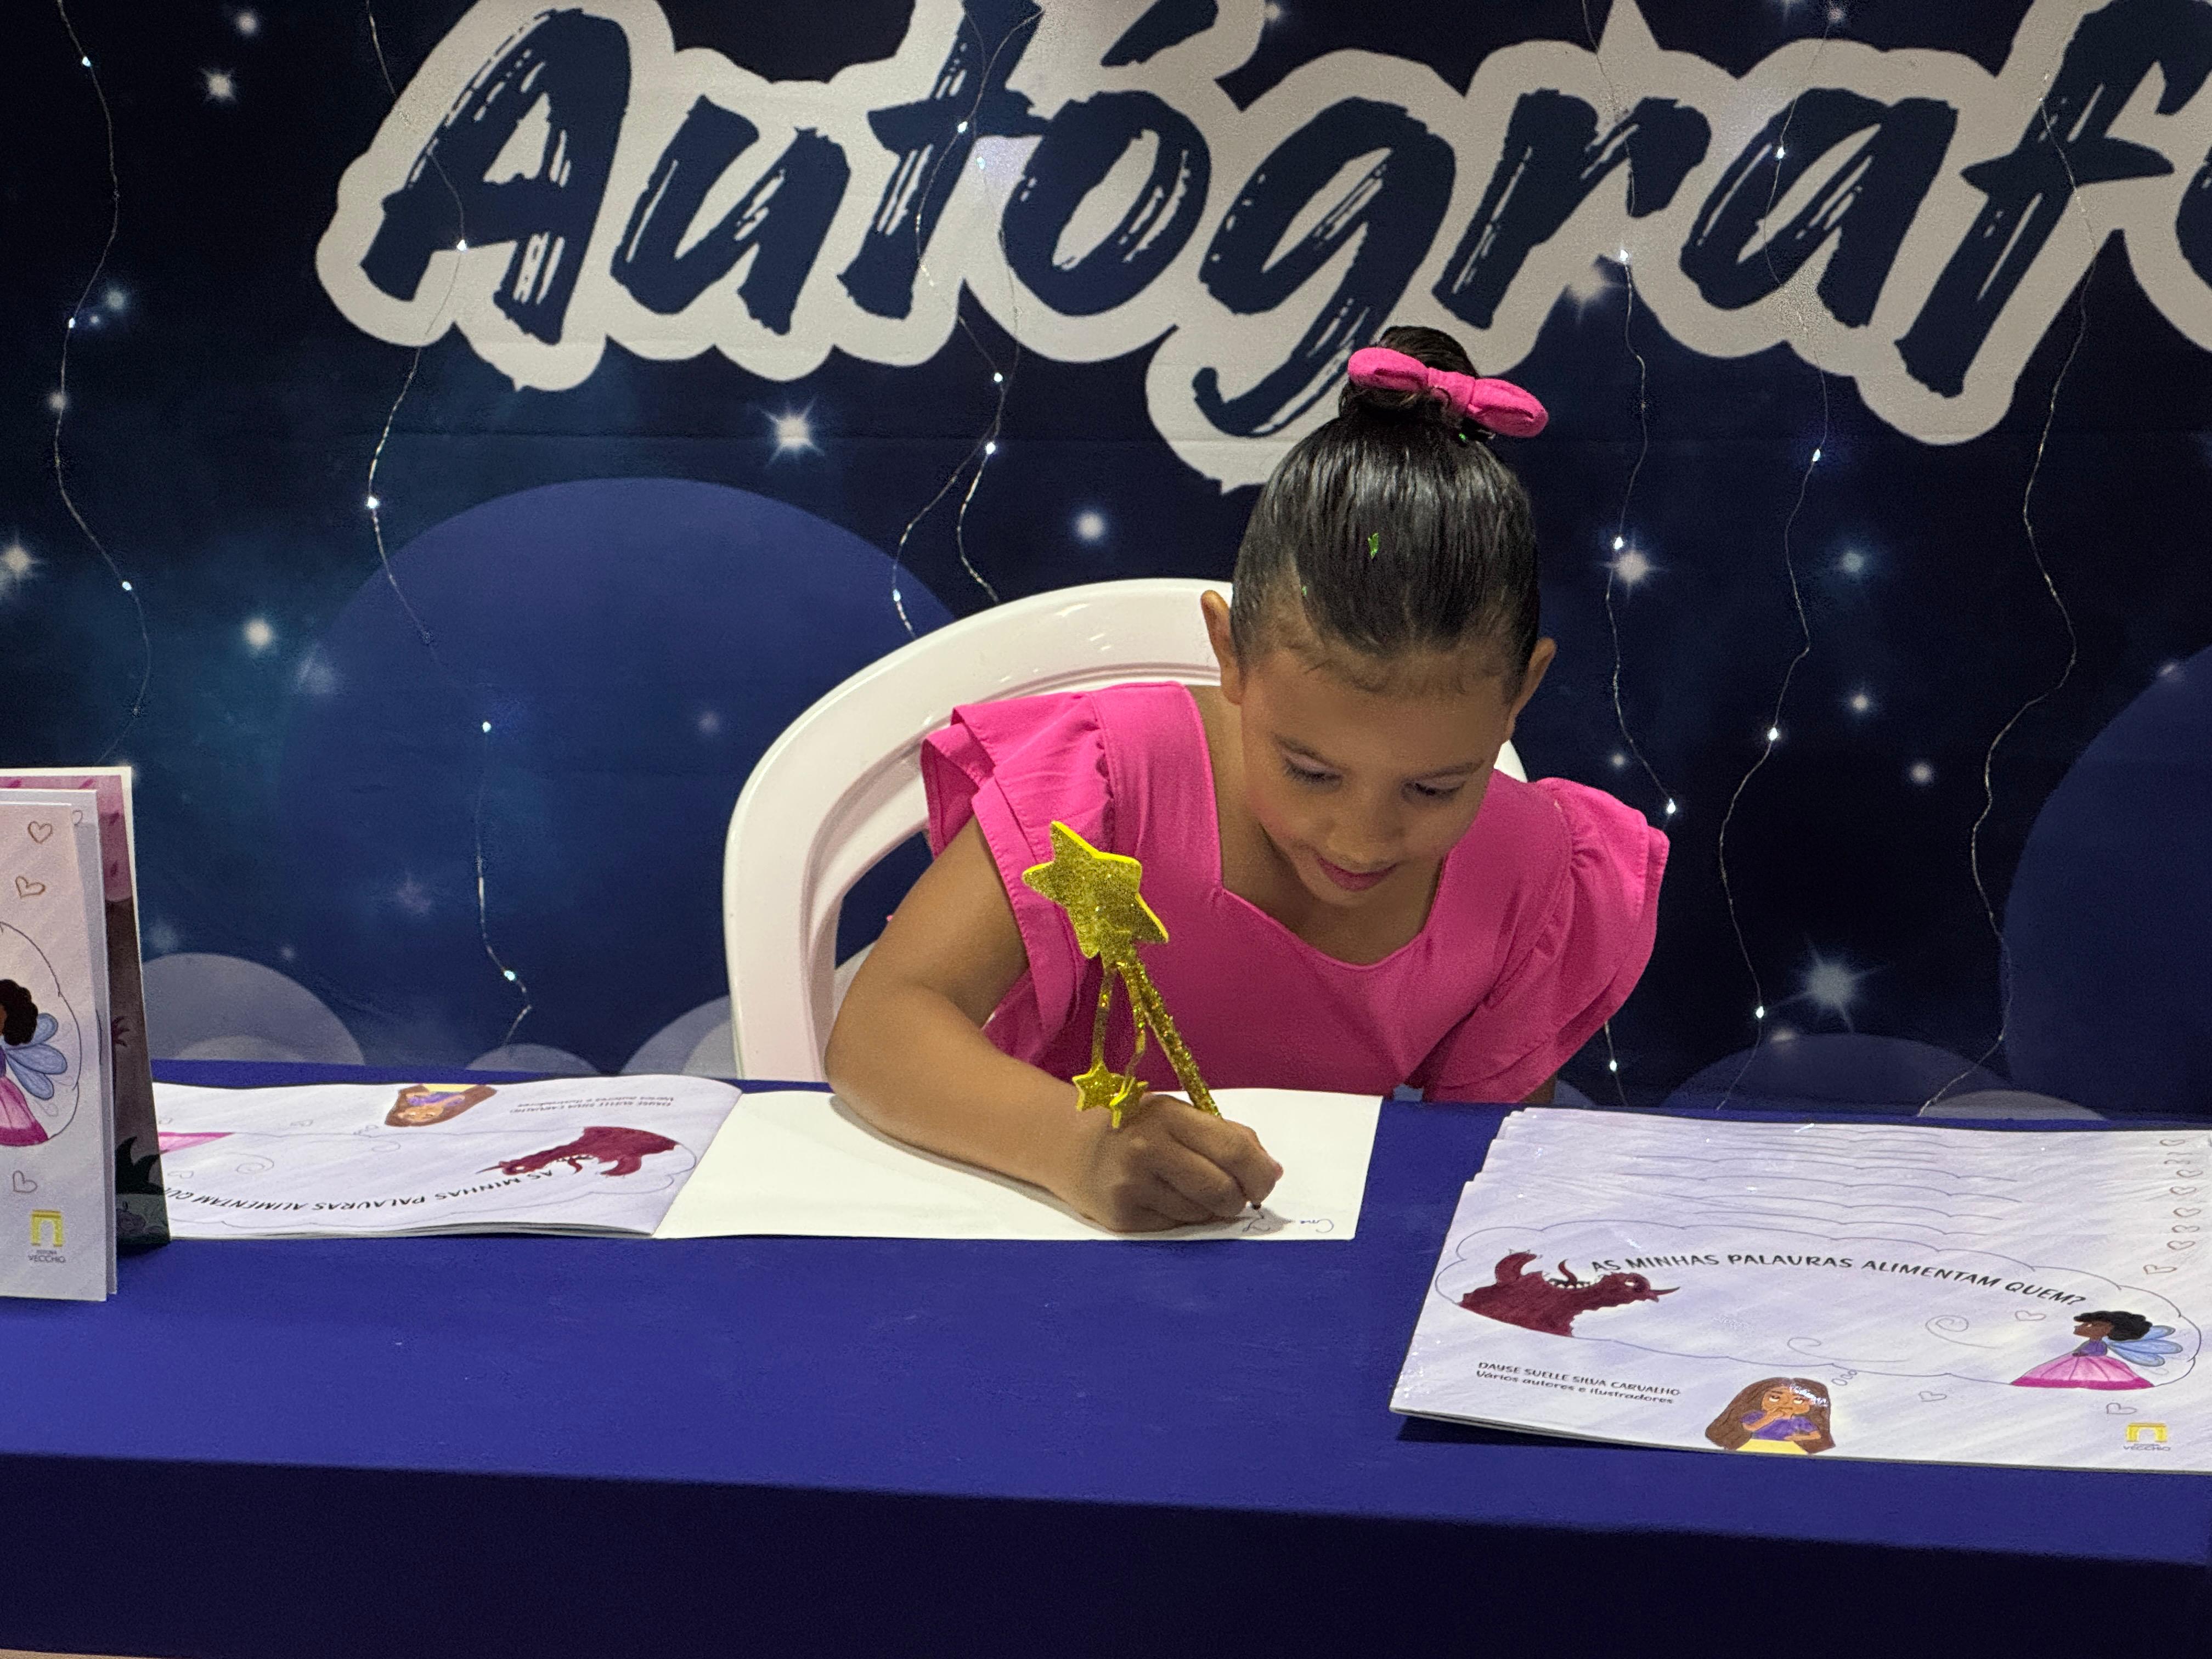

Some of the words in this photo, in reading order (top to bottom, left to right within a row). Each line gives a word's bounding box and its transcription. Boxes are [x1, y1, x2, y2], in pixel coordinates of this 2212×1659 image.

[359, 0, 2212, 437] Autógraf
[527, 1170, 552, 1180] AS
[435, 1178, 522, 1200] MINHAS
[191, 1195, 309, 1210] ALIMENTAM
[1592, 1260, 1621, 1273] AS
[1627, 1254, 1720, 1269] MINHAS
[1861, 1260, 2003, 1287] ALIMENTAM
[2005, 1281, 2086, 1305] QUEM?
[1522, 1378, 1575, 1391] autores
